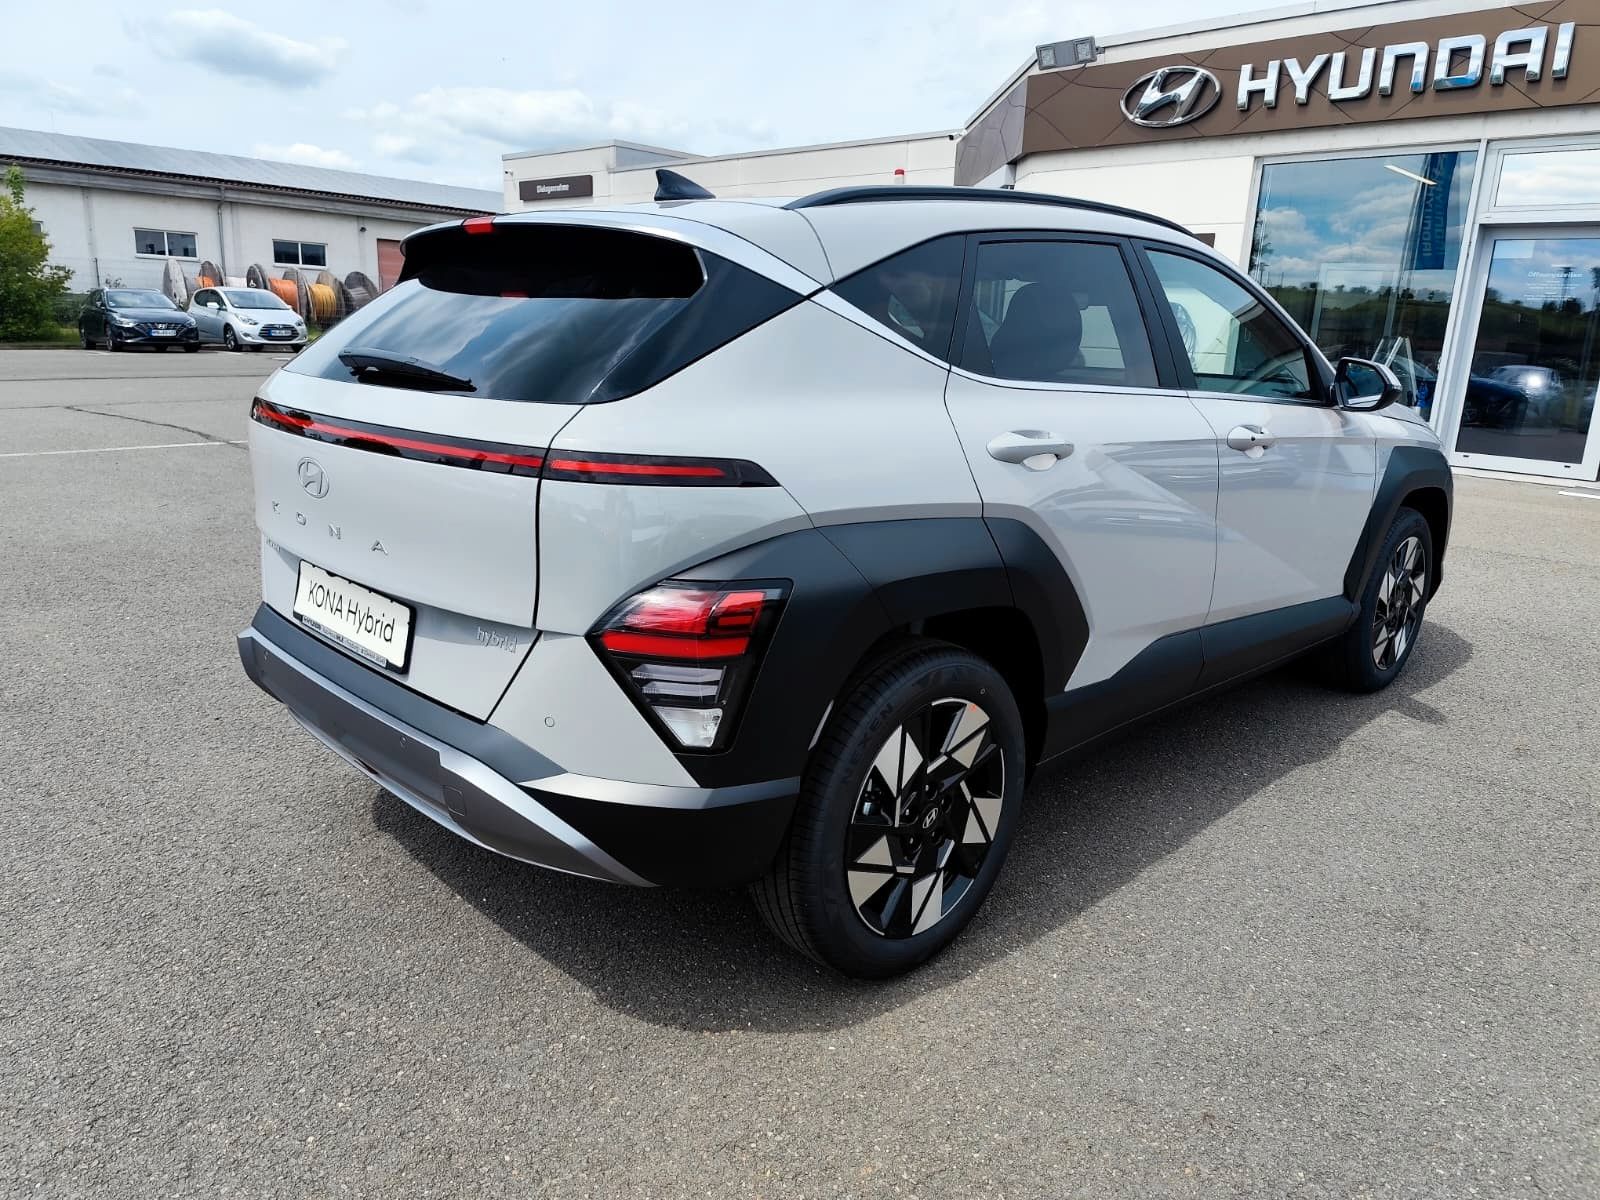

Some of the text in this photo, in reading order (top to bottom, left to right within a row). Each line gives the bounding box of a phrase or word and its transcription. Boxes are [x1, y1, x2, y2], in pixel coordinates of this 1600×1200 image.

[1236, 21, 1576, 111] HYUNDAI
[271, 500, 389, 555] KONA
[308, 580, 343, 619] KONA
[346, 599, 395, 643] Hybrid
[476, 626, 518, 654] hybrid
